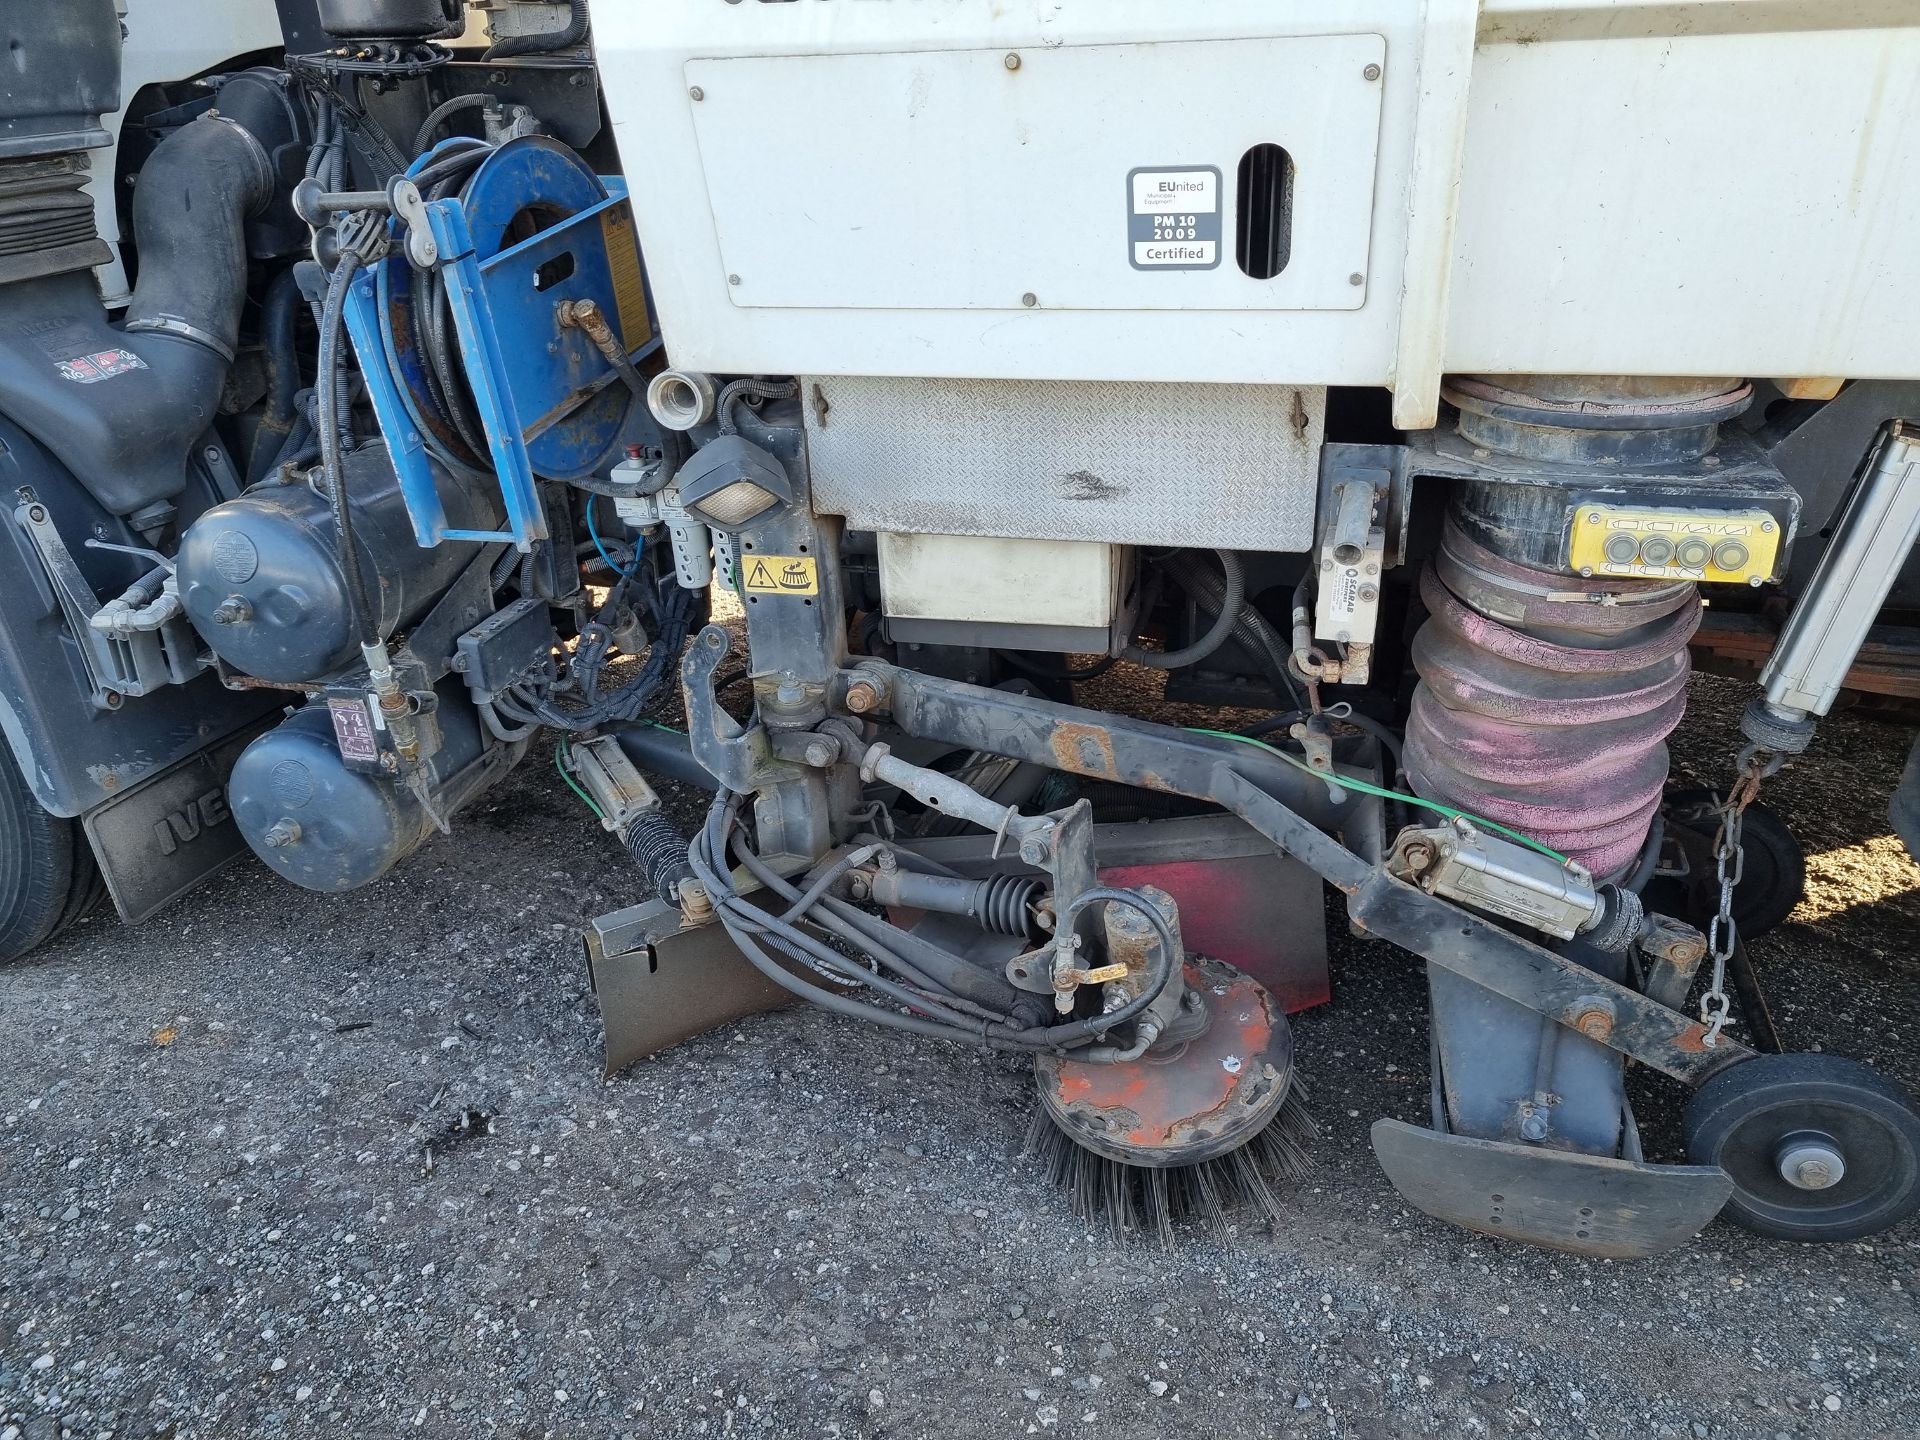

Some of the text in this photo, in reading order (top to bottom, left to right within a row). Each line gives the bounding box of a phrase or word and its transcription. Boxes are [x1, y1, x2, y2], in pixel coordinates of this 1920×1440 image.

[1159, 181, 1204, 192] EUnited
[1154, 215, 1196, 227] PM 10
[1154, 228, 1196, 240] 2009
[1146, 247, 1204, 259] Certified
[1346, 578, 1358, 613] SCARAB
[153, 785, 230, 856] IVE
